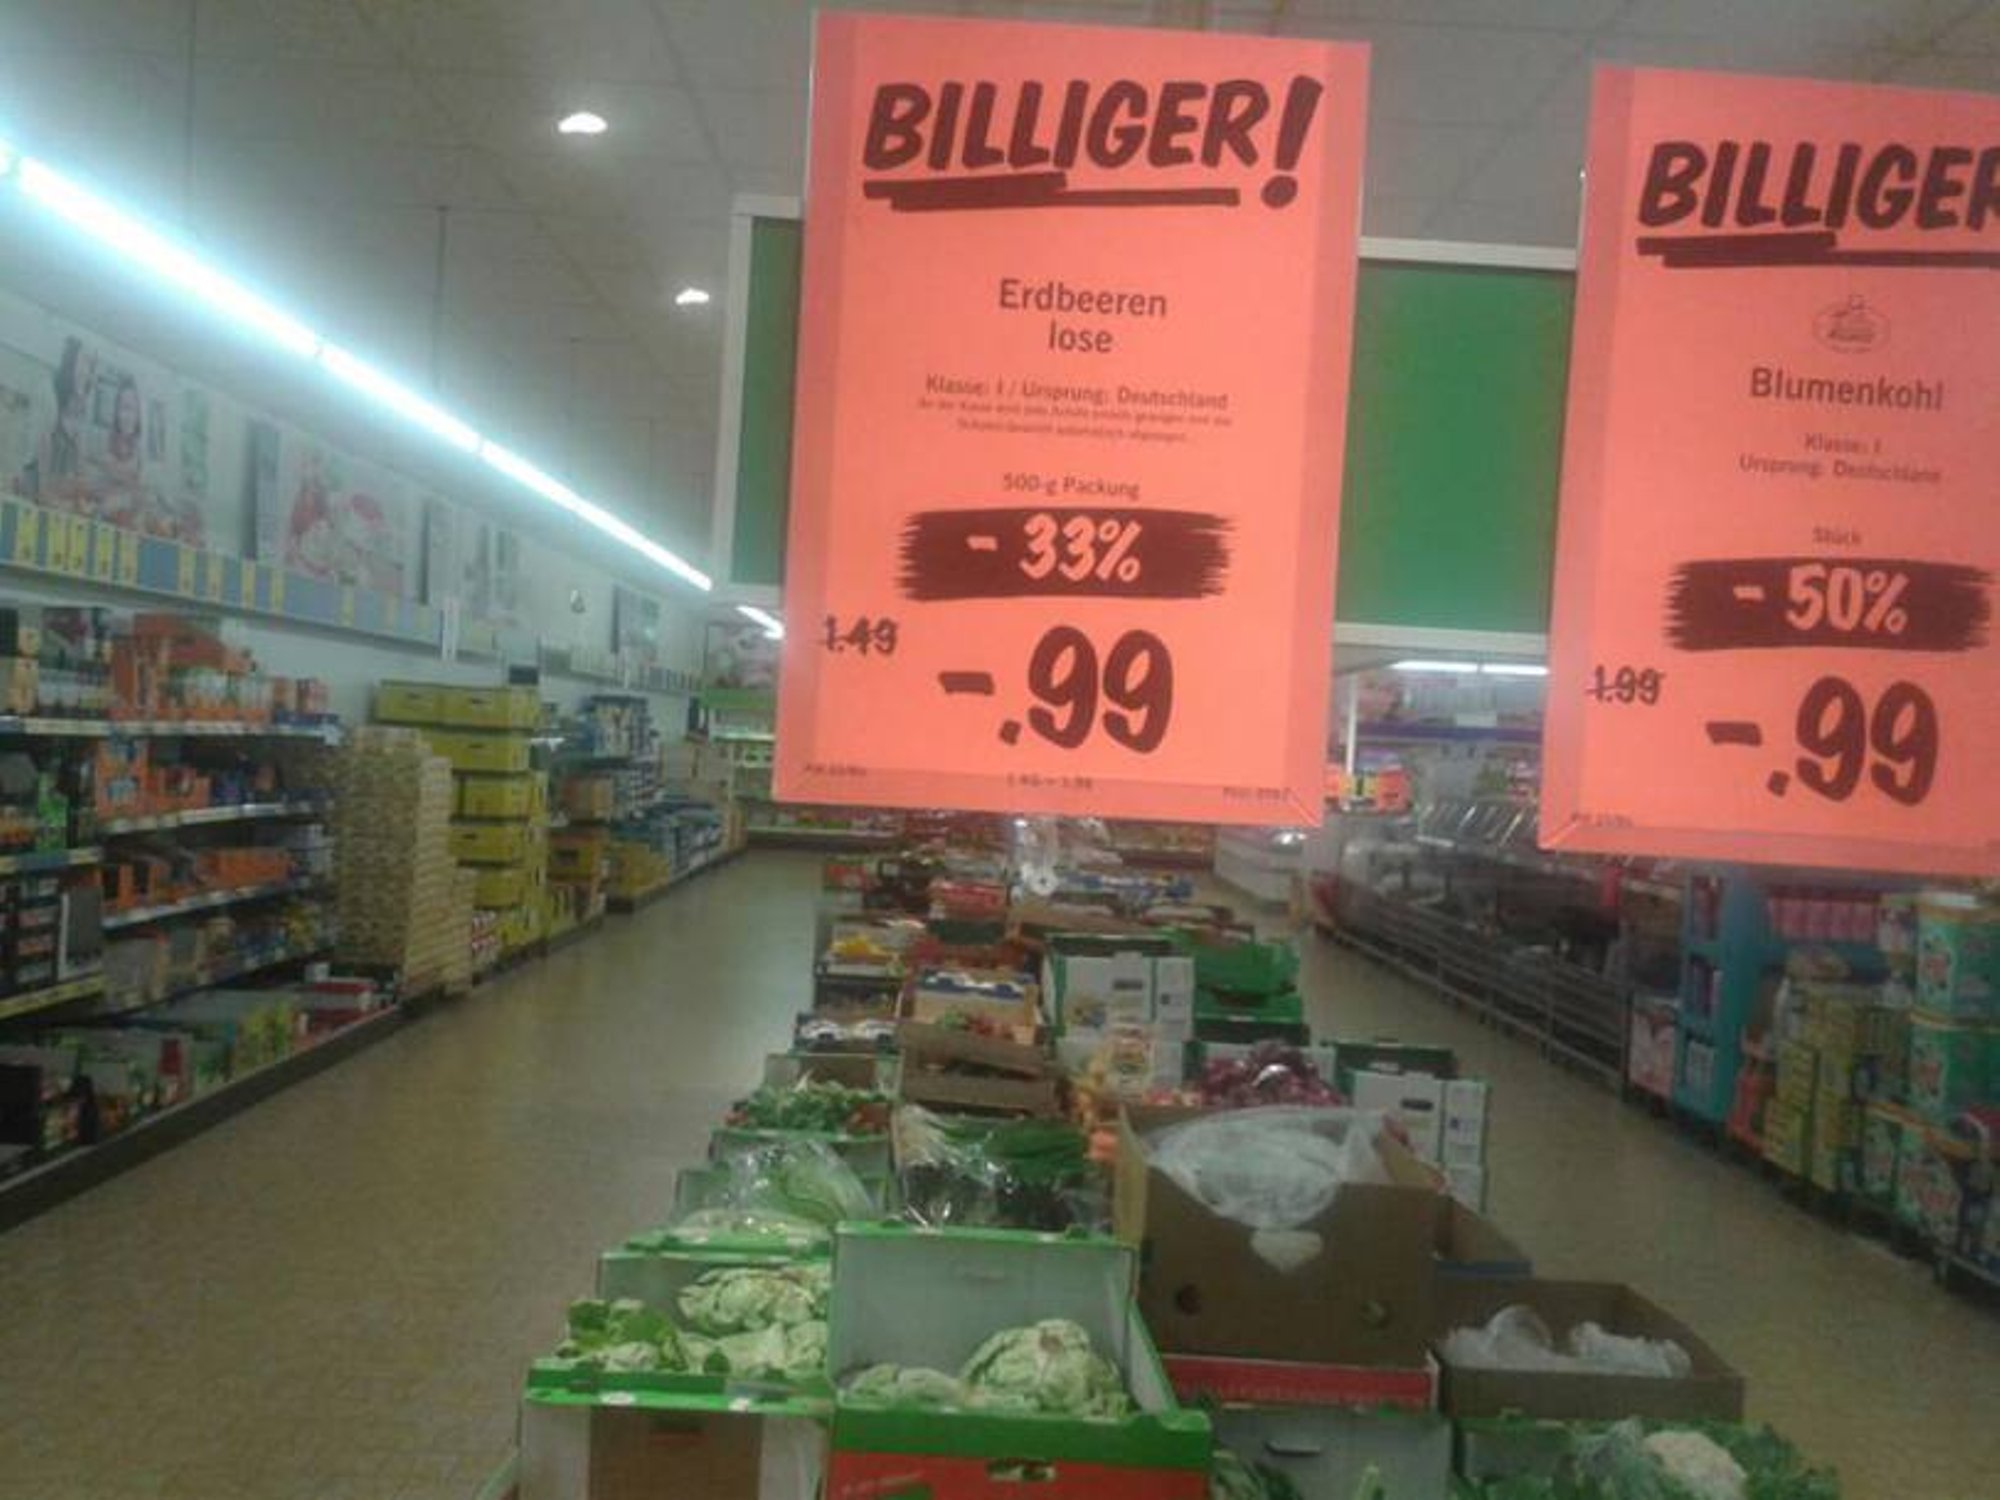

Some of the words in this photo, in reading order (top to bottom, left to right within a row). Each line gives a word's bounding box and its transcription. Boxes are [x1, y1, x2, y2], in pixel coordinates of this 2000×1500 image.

[863, 75, 1324, 209] BILLIGER!
[999, 279, 1168, 318] Erdbeeren
[1048, 321, 1114, 354] lose
[1117, 386, 1229, 410] Deutschland
[1751, 366, 1945, 412] Blumenkohl
[1063, 475, 1140, 499] Packung
[1018, 513, 1142, 582] 33%
[1785, 563, 1909, 635] 50%
[821, 614, 899, 656] 1.49
[1588, 665, 1663, 706] 1.99
